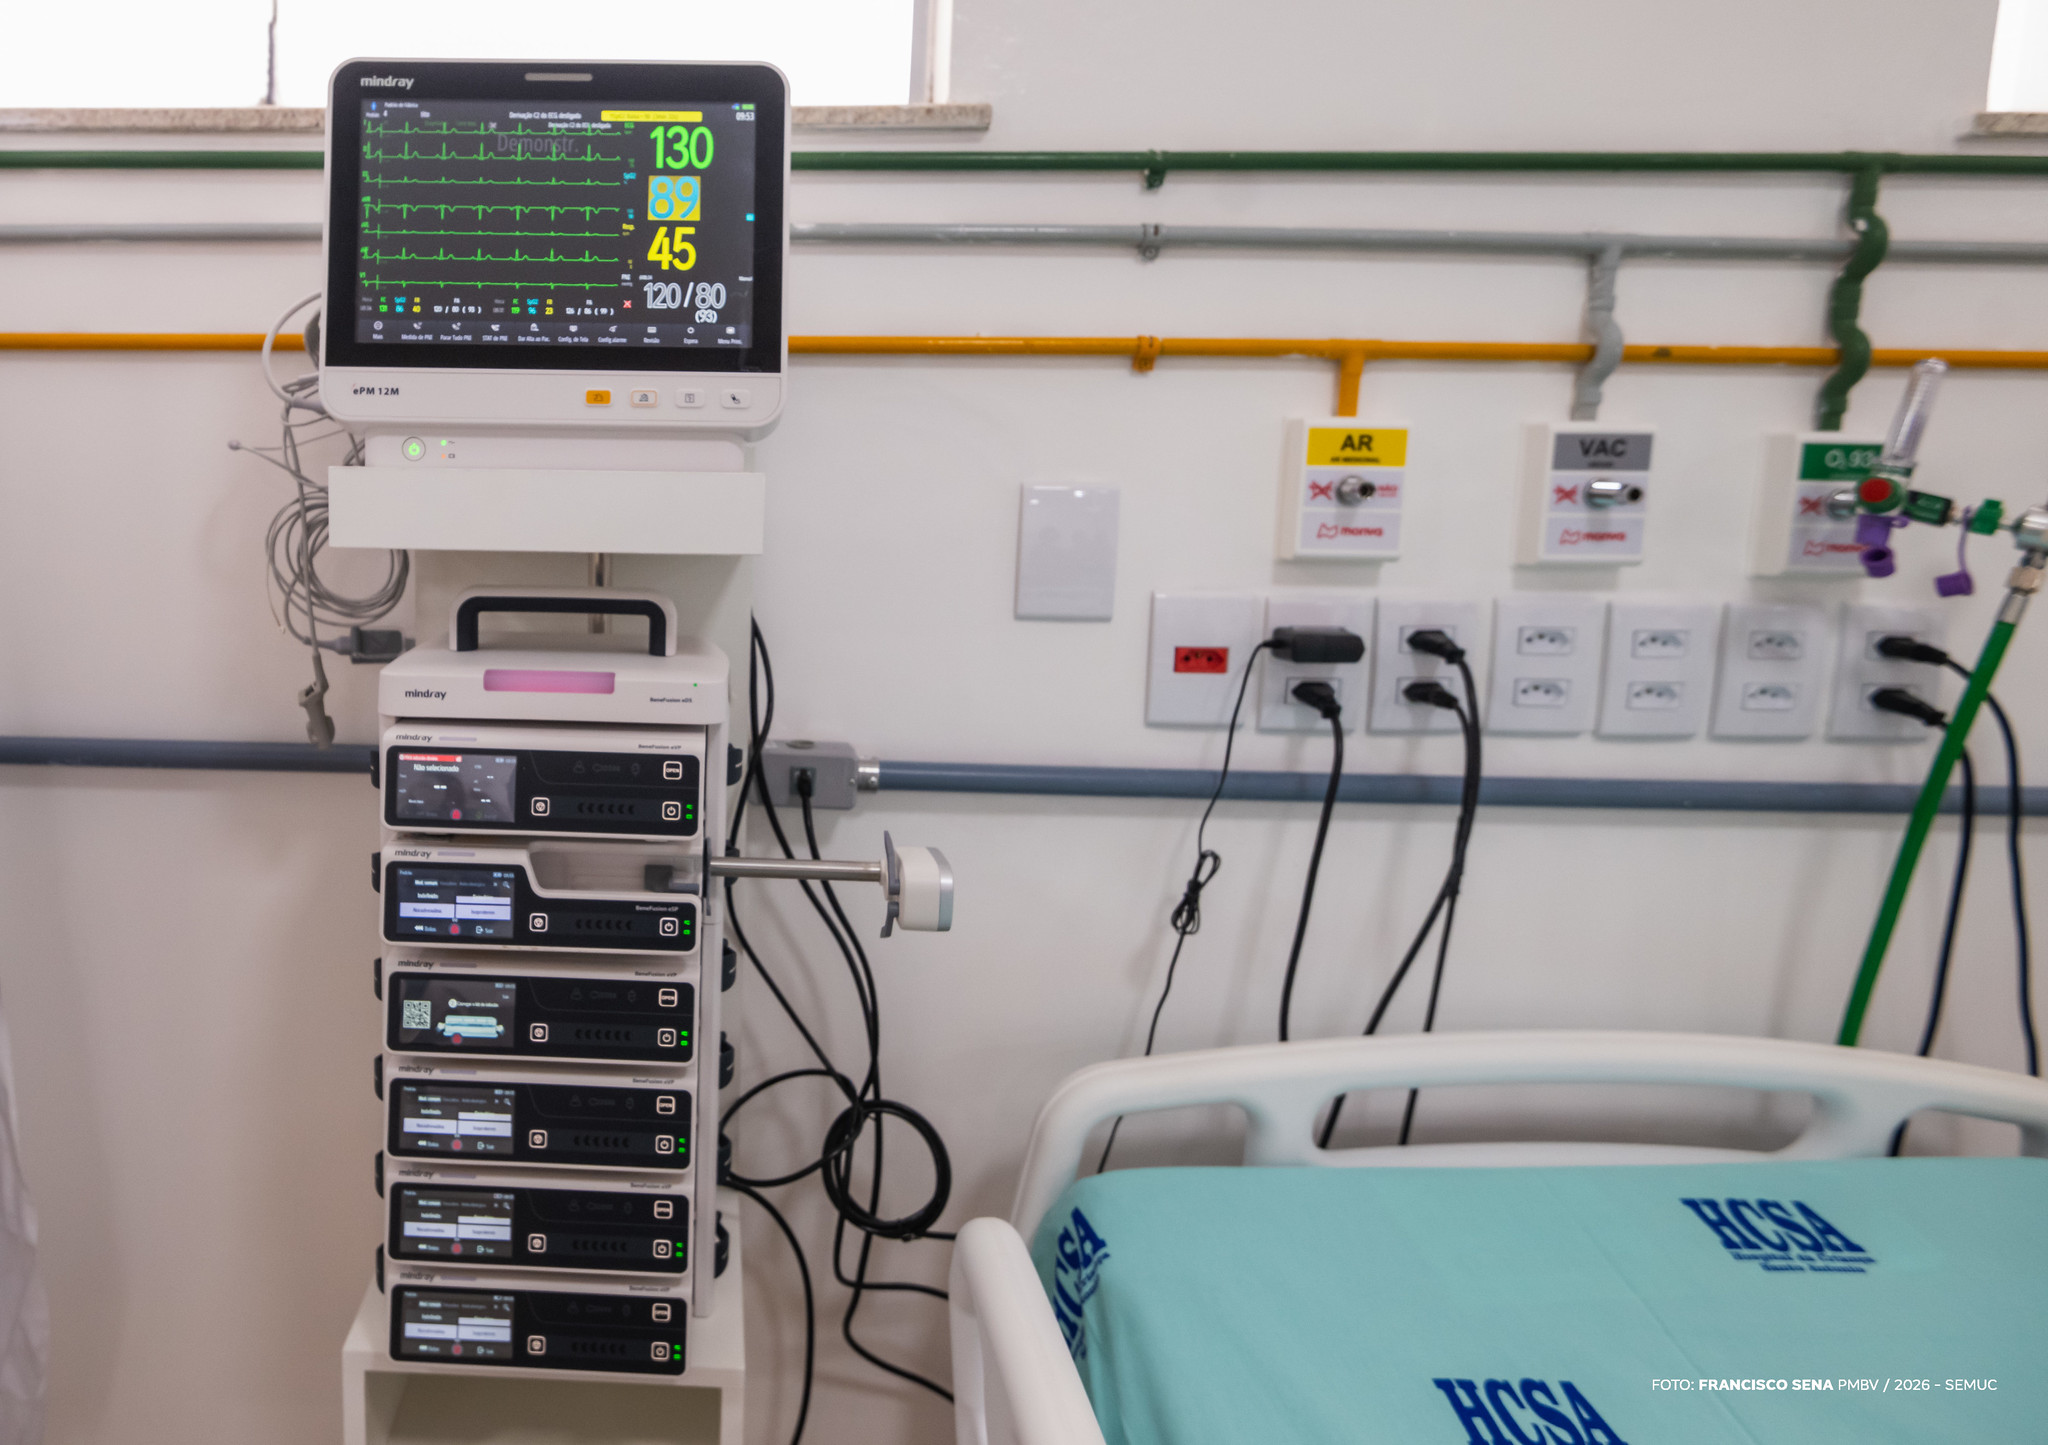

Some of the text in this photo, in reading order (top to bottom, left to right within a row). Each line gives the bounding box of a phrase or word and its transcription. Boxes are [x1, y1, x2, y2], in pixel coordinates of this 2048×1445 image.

[360, 76, 414, 89] mindray
[736, 112, 755, 121] 09:53
[497, 134, 578, 152] Demonstr.
[650, 125, 714, 169] 130
[649, 176, 699, 218] 89
[647, 226, 697, 271] 45
[353, 387, 400, 395] ePM 12M
[1340, 434, 1373, 452] AR
[1580, 438, 1627, 458] VAC
[405, 690, 446, 700] mindray
[396, 734, 432, 742] mindray
[413, 763, 460, 772] Não selecionado
[395, 848, 431, 859] mindray
[398, 960, 434, 969] mindray
[398, 1064, 434, 1075] mindray
[398, 1169, 434, 1179] mindray
[1679, 1198, 1866, 1251] HCSA
[399, 1271, 435, 1282] mindray
[1432, 1378, 1629, 1445] HCSA
